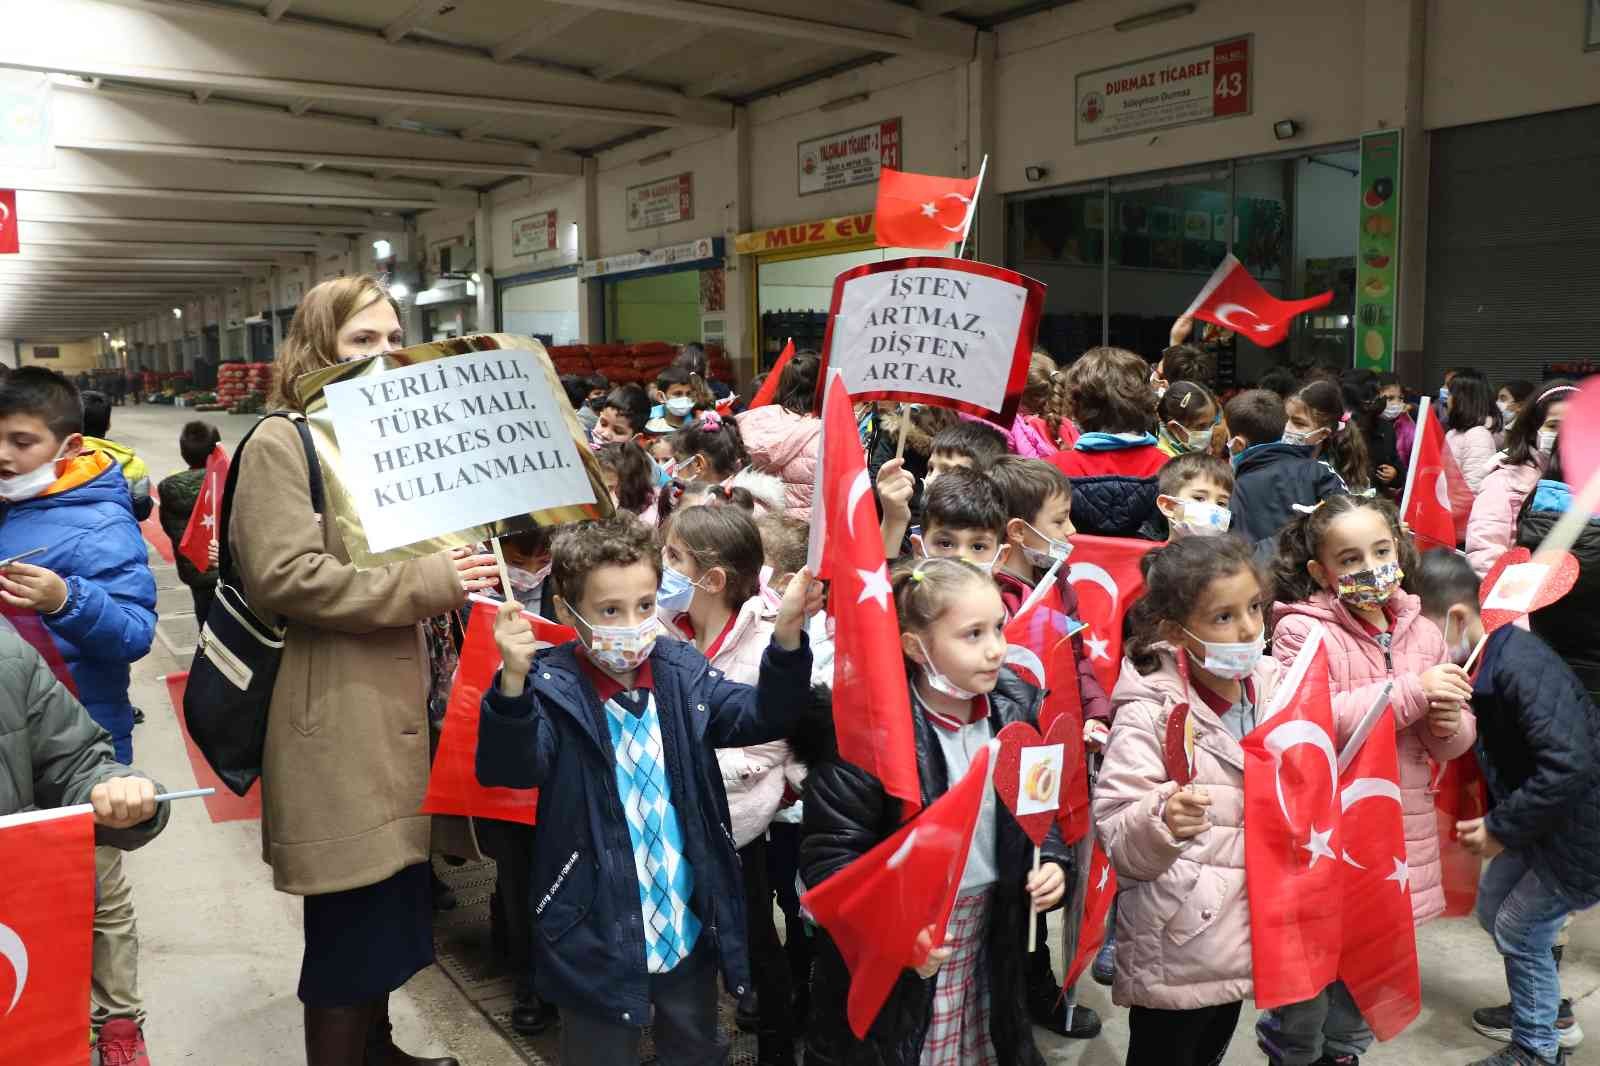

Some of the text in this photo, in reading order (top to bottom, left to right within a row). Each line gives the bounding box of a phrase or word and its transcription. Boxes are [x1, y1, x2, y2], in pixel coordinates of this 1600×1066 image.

[1105, 59, 1211, 97] DURMAZ TİCARET
[1215, 72, 1243, 99] 43
[766, 222, 825, 248] MUZ
[890, 274, 971, 300] İŞTEN
[863, 306, 986, 339] ARTMAZ,
[869, 330, 969, 360] DİŞTEN
[359, 359, 530, 407] YERLİ MALI,
[863, 362, 963, 389] ARTAR.
[370, 390, 537, 439] TÜRK MALI.
[373, 419, 553, 474] HERKES ONU
[373, 449, 572, 508] KULLANMALI.
